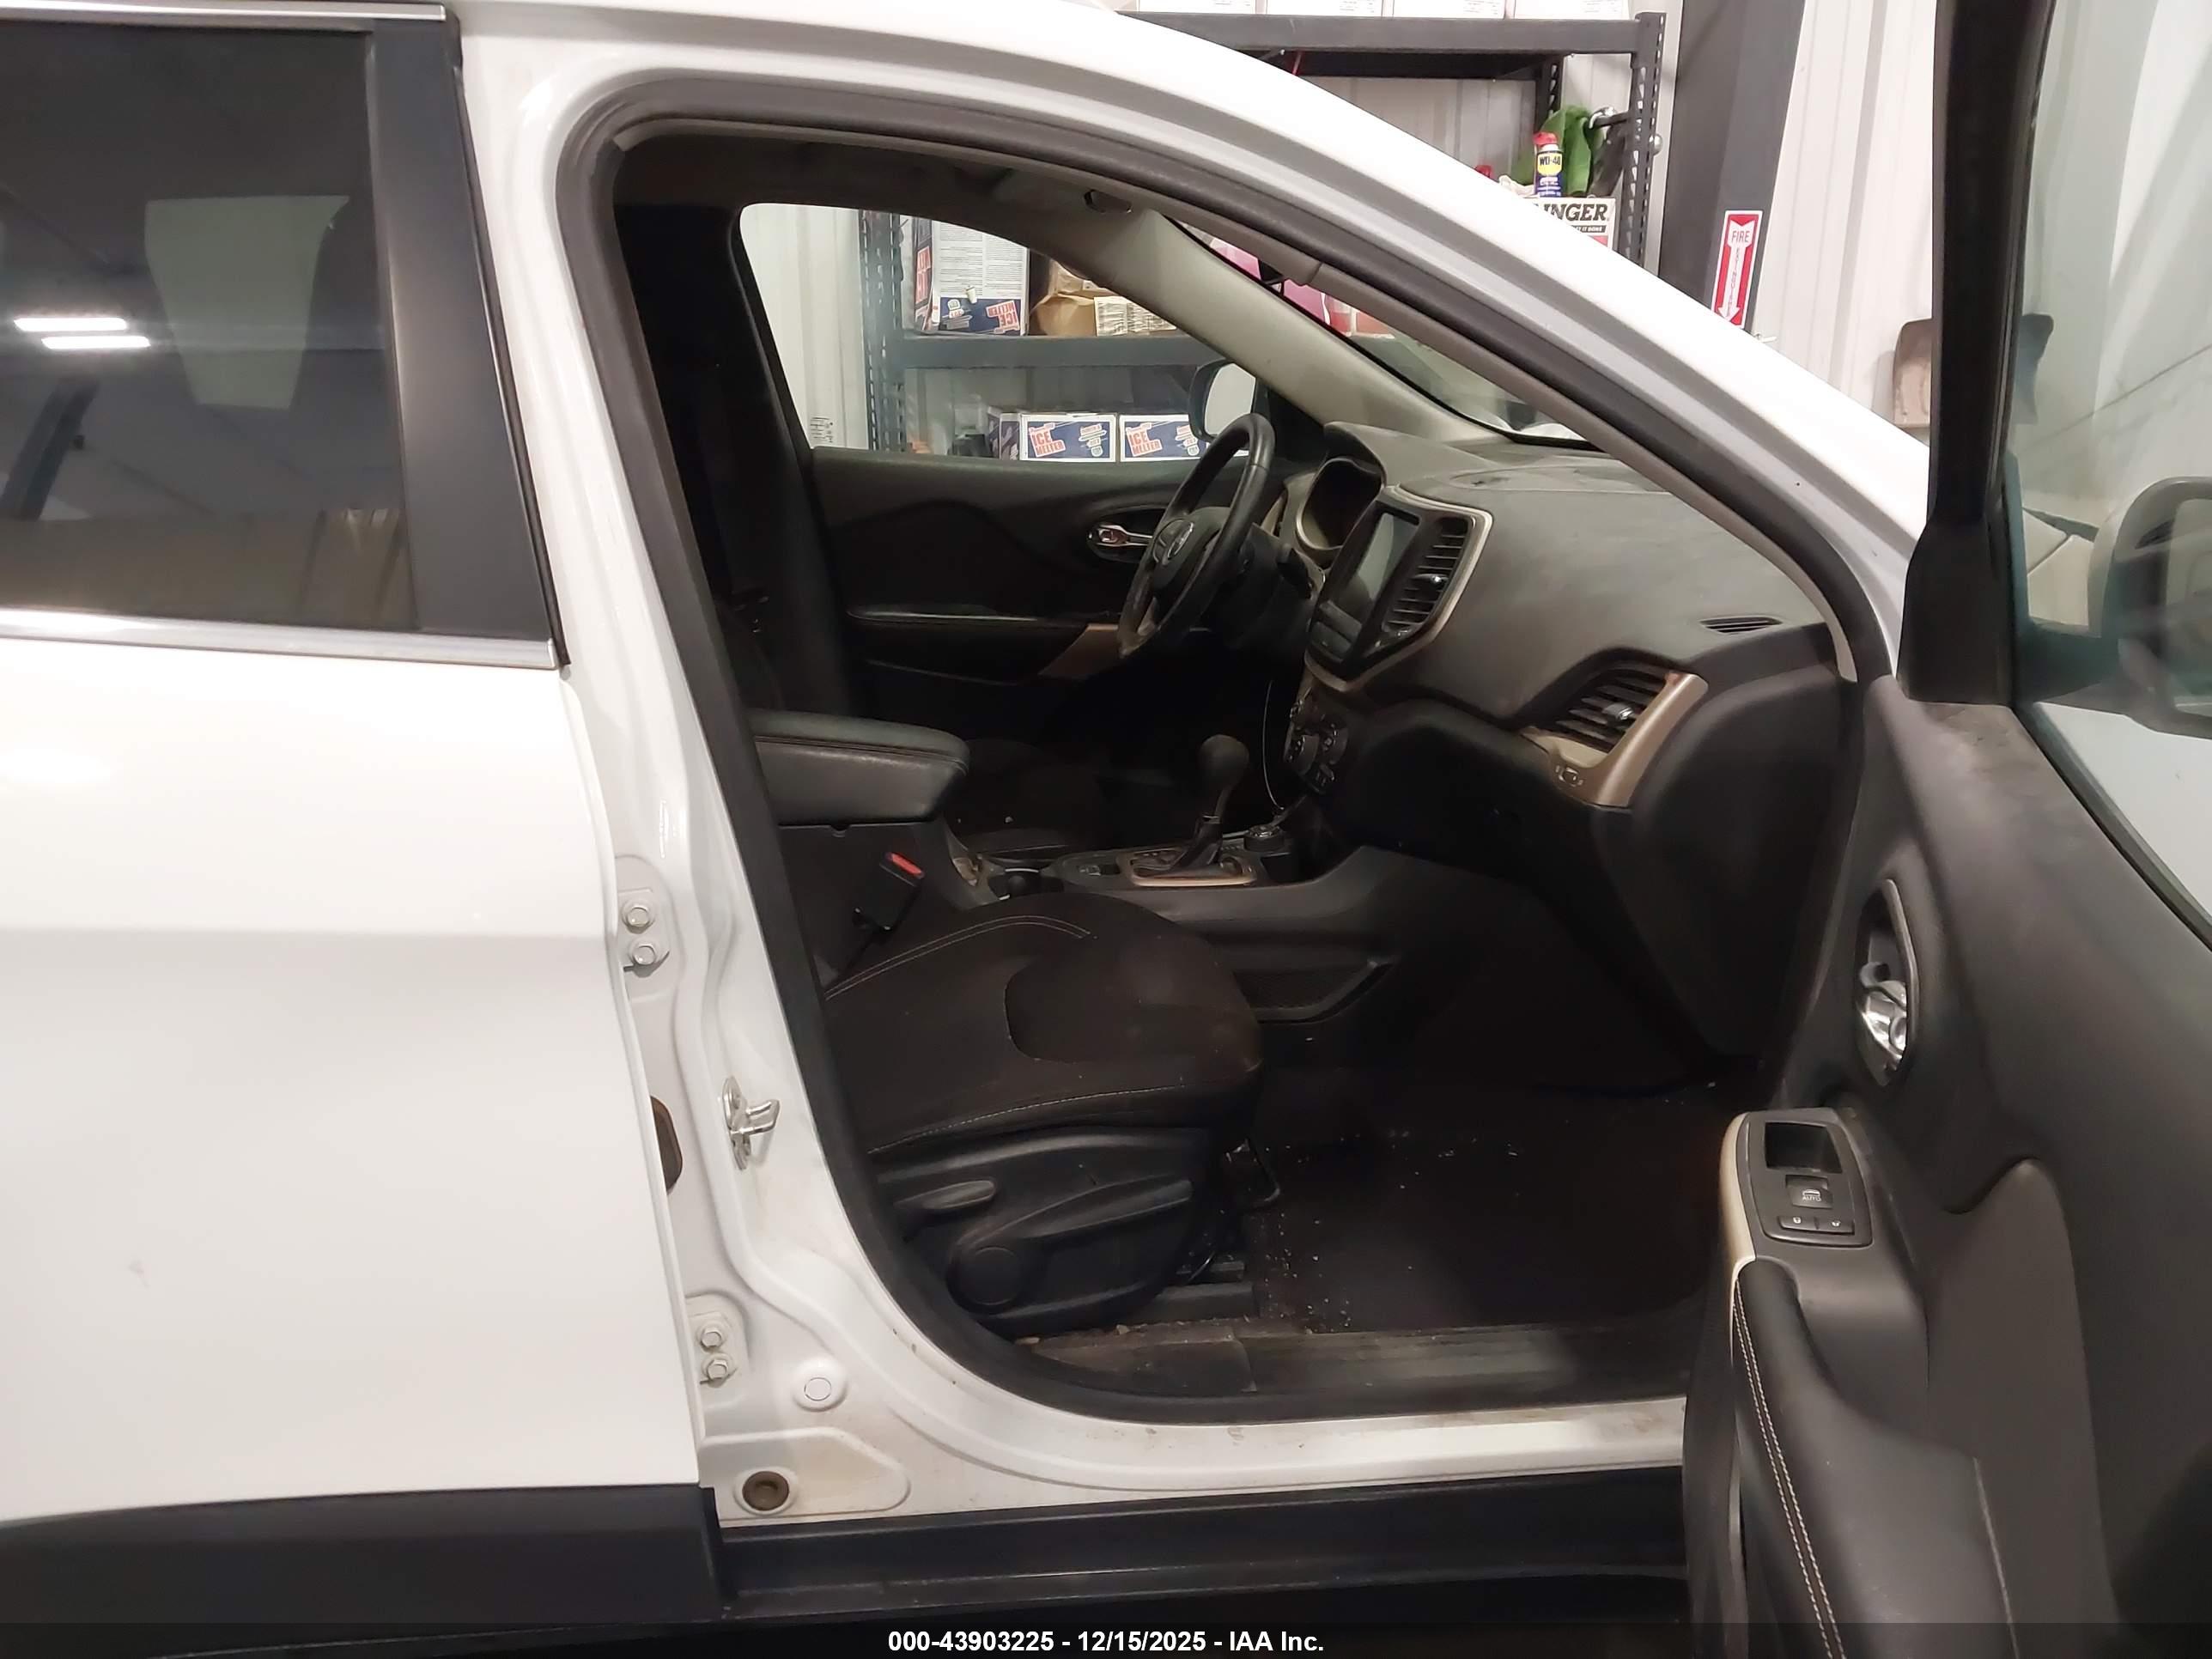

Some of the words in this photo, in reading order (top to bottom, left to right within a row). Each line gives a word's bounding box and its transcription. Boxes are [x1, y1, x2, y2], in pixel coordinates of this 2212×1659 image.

[1540, 156, 1561, 165] WD-40
[1732, 230, 1750, 243] FIRE
[999, 313, 1017, 325] ICE
[1031, 430, 1052, 446] ICE
[1128, 430, 1149, 446] ICE
[1036, 441, 1065, 454] MELTER
[1133, 441, 1160, 454] MELTER
